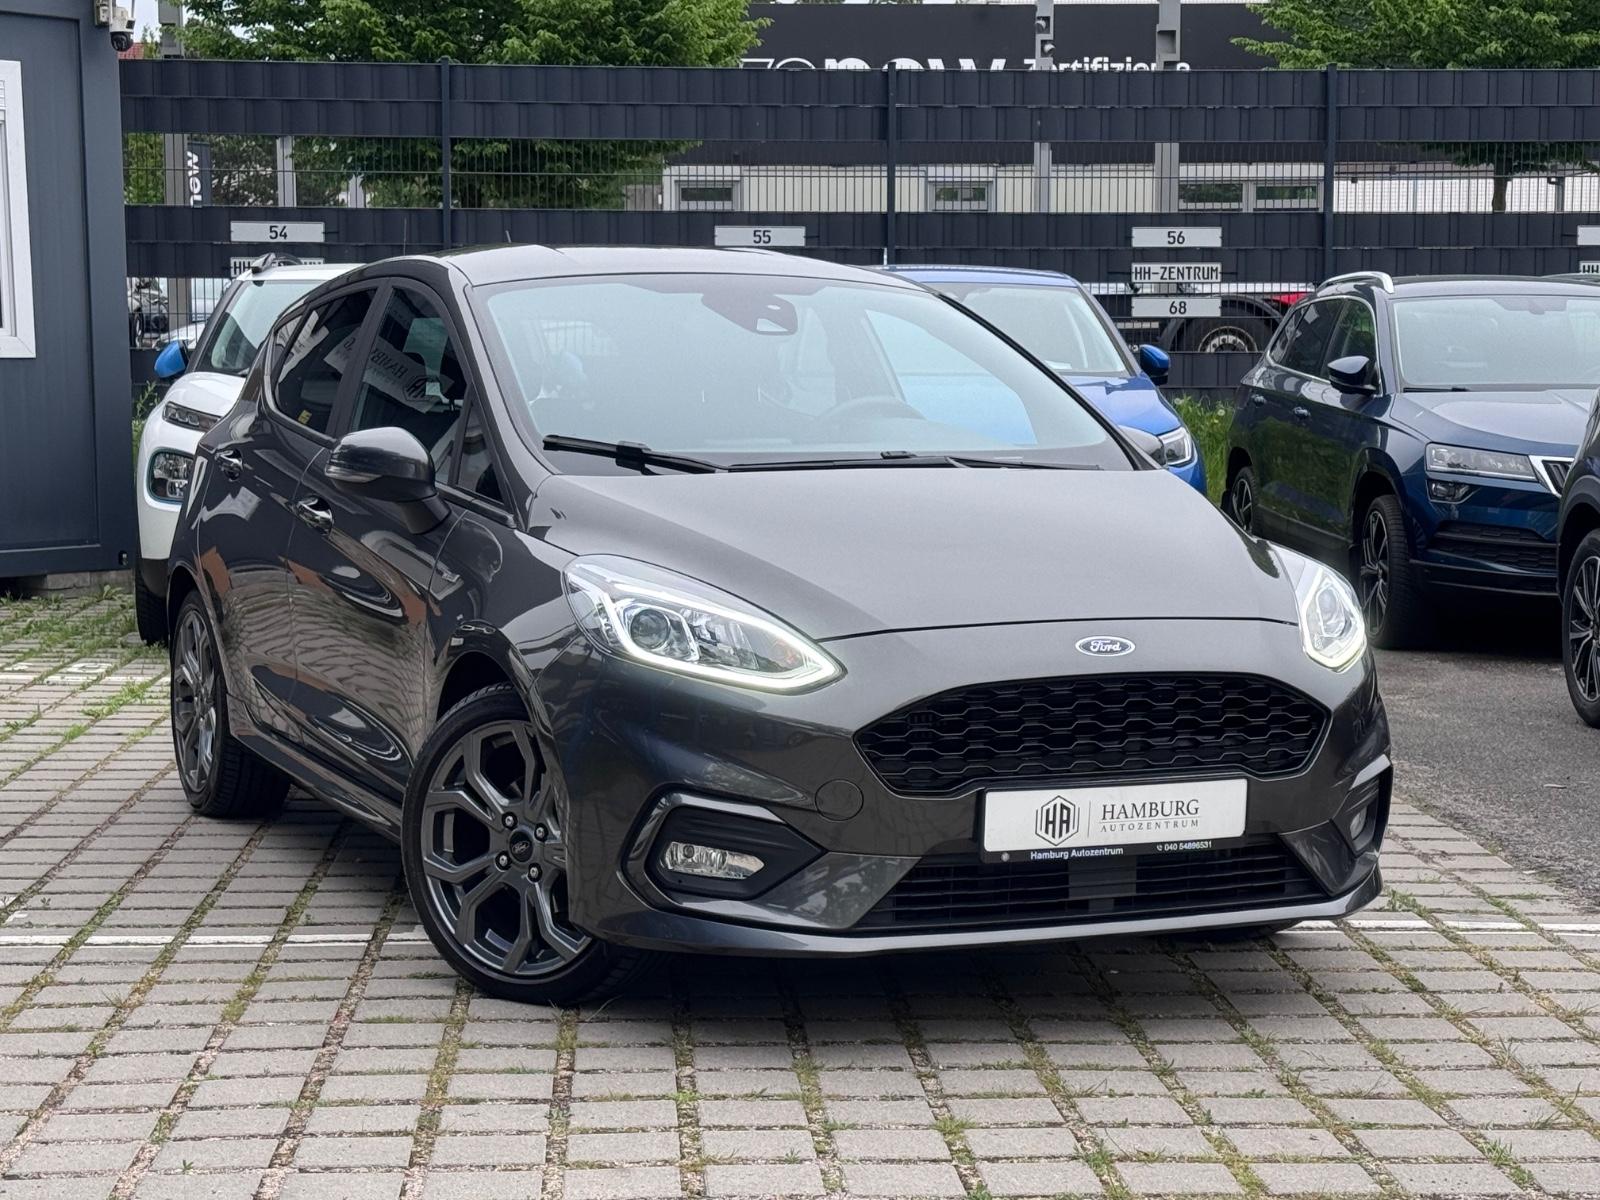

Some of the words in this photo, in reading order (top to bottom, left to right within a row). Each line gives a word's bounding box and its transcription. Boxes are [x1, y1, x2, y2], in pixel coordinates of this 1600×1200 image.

[269, 225, 288, 240] 54
[753, 229, 772, 244] 55
[1167, 230, 1186, 245] 56
[1134, 266, 1219, 281] HH-ZENTRUM
[1169, 300, 1188, 315] 68
[1089, 640, 1122, 652] Ford
[1101, 799, 1200, 821] HAMBURG
[1101, 819, 1199, 832] AUTOZENTRUM
[1030, 850, 1069, 860] Hamburg
[1070, 847, 1124, 857] Autozentrum
[1164, 842, 1178, 851] 040
